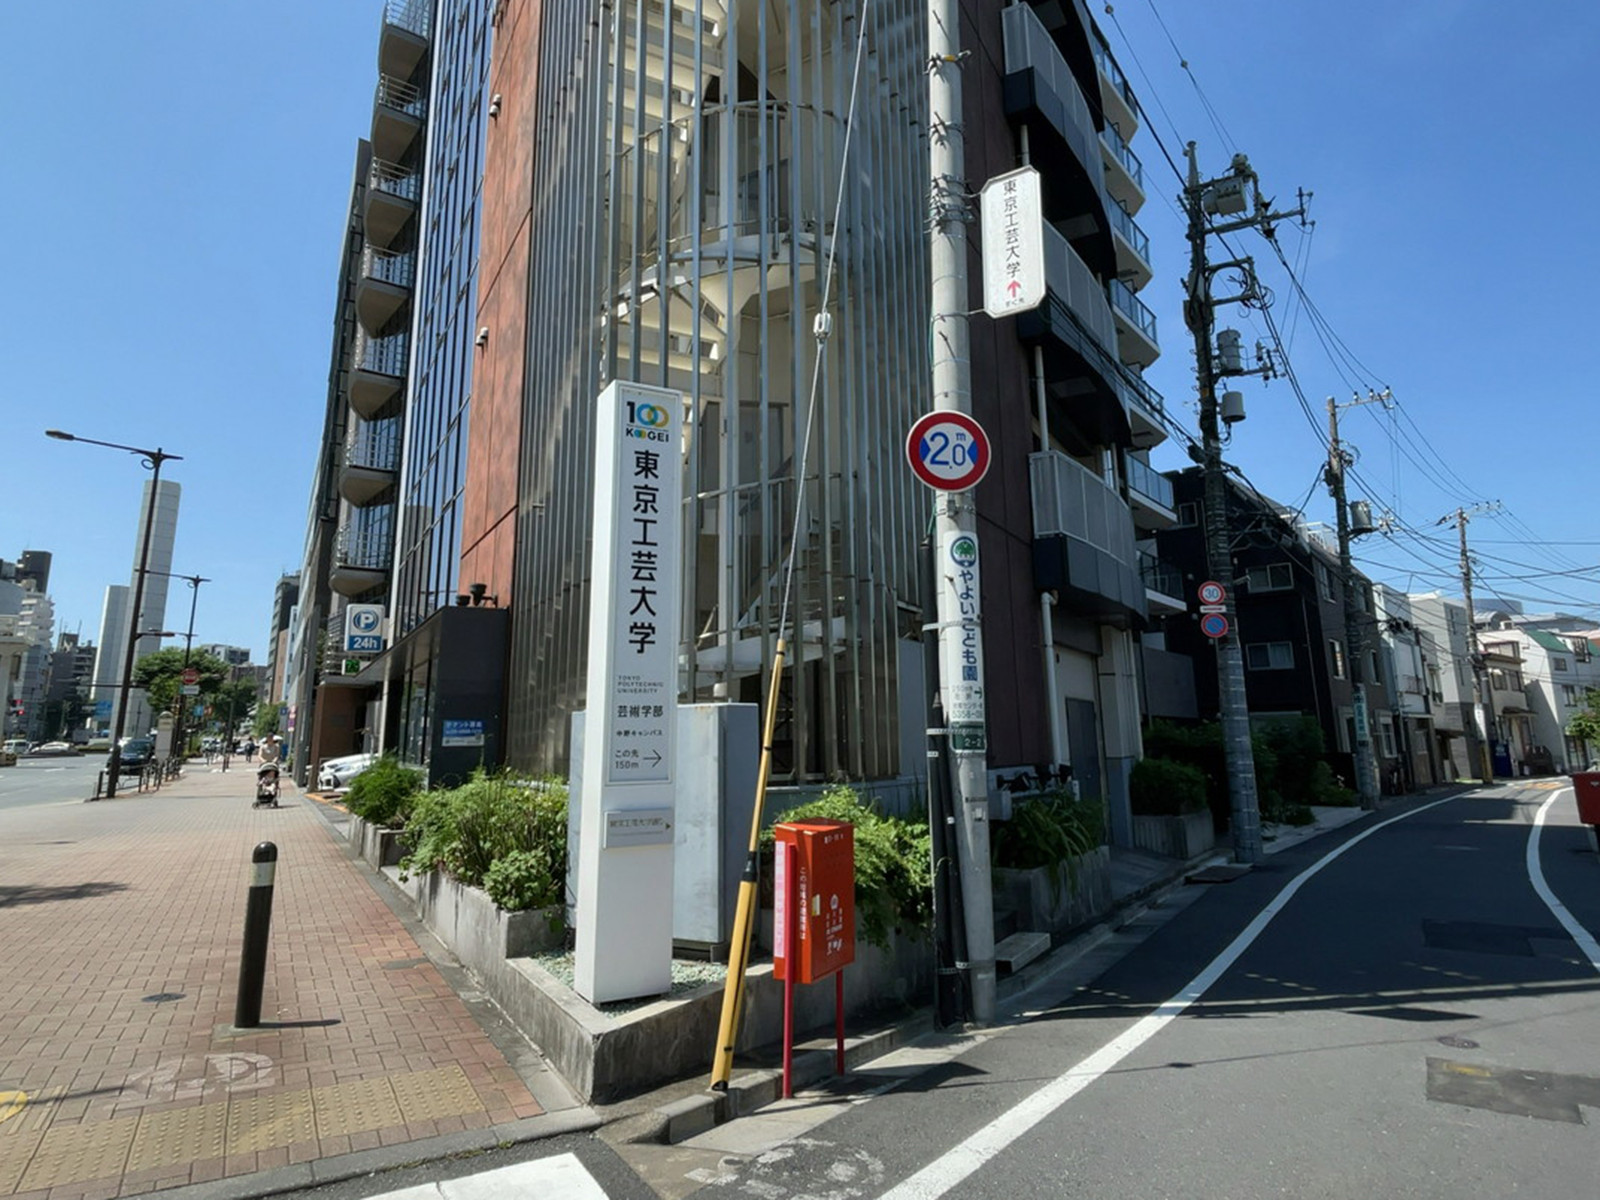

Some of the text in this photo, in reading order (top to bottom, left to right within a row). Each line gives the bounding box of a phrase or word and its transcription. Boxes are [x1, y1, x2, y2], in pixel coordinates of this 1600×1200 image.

[1003, 179, 1021, 278] 東京工芸大学
[629, 450, 660, 654] 東京工芸大学
[1204, 588, 1219, 599] 30
[959, 569, 978, 681] やよいこども園
[353, 637, 378, 649] 24h
[617, 704, 664, 718] 芸術学部
[615, 749, 640, 758] この先
[615, 761, 640, 769] 150m
